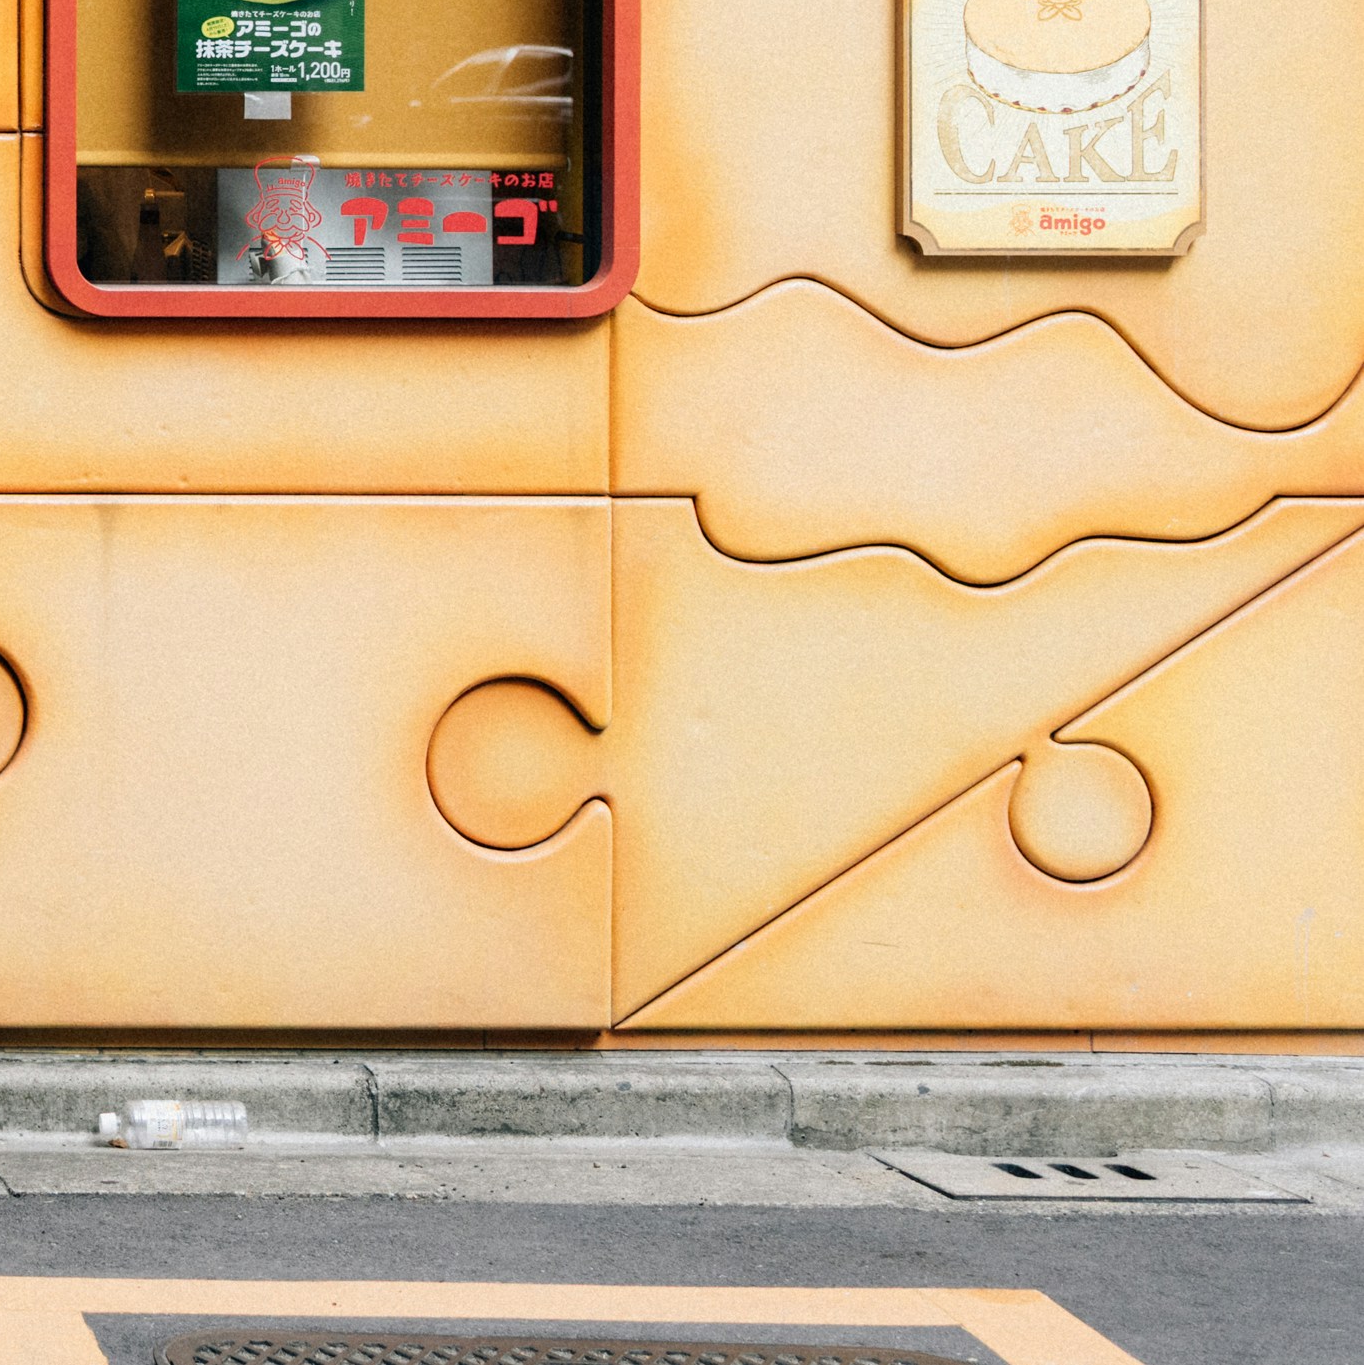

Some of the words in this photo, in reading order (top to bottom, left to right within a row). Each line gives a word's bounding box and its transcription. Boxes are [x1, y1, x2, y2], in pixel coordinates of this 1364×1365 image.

[236, 20, 322, 38] アミーゴの
[195, 39, 342, 59] 抹茶チーズケーキ
[297, 61, 351, 82] 1,200円
[936, 70, 1179, 185] CAKE
[278, 177, 306, 189] amigo
[344, 172, 555, 188] 焼きたてチーズケーキのお店
[340, 196, 558, 246] アミーゴ
[1038, 213, 1107, 236] amigo
